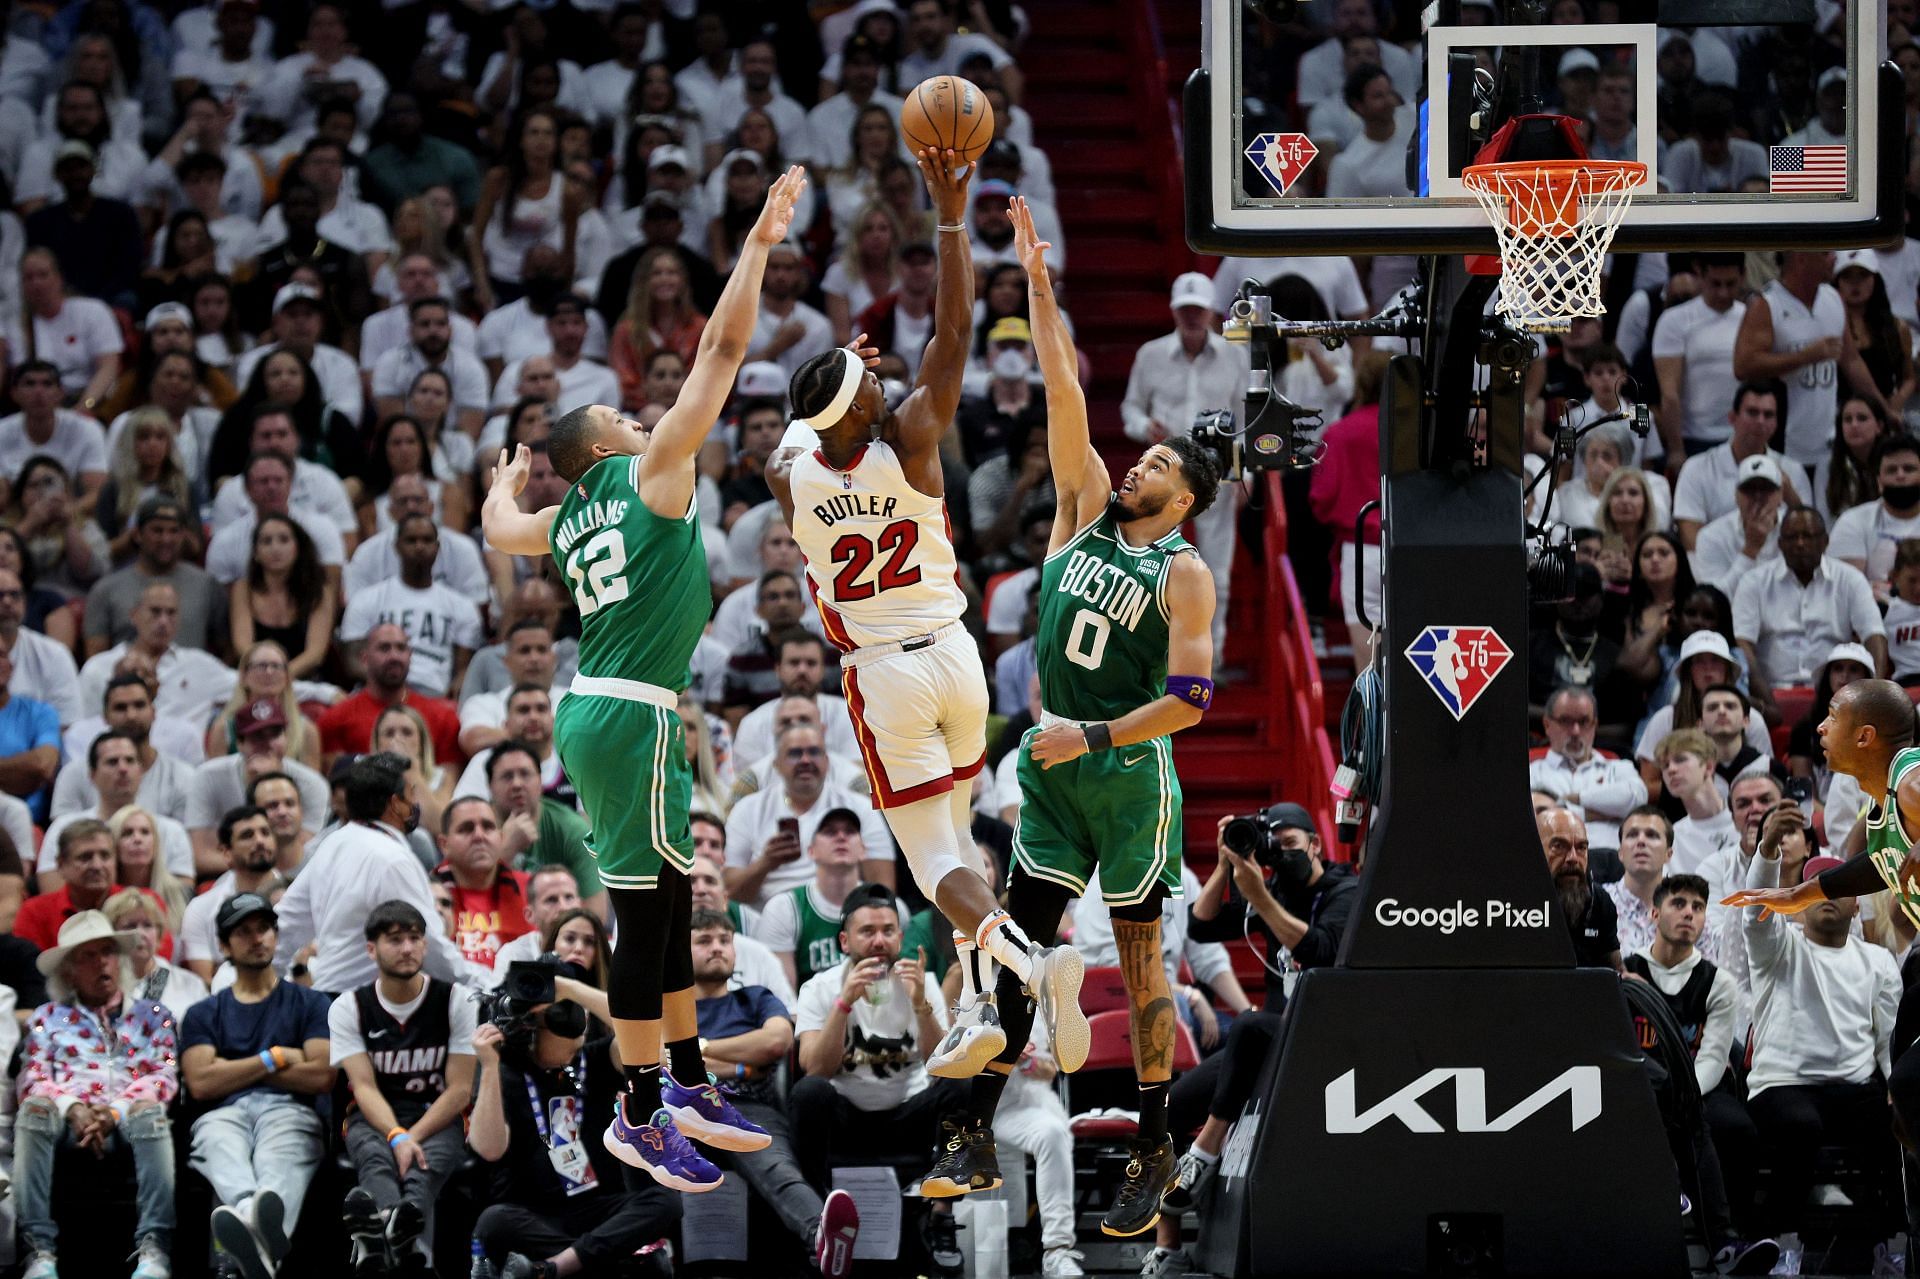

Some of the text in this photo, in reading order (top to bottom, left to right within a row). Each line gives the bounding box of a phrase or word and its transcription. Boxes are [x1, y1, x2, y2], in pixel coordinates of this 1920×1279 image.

[1288, 143, 1301, 160] 75
[555, 500, 628, 553] WILLIAMS
[813, 495, 897, 527] BUTLER
[566, 529, 630, 616] 12
[831, 519, 922, 602] 22
[1136, 565, 1158, 577] PRINT
[1139, 558, 1160, 570] VISTA
[1058, 550, 1152, 633] BOSTON
[1065, 608, 1111, 671] 0
[1468, 640, 1488, 667] 75
[1188, 684, 1210, 703] 24
[1375, 898, 1550, 934] Google Pixel
[368, 1046, 446, 1074] MIAMI
[1325, 1065, 1602, 1134] KIA
